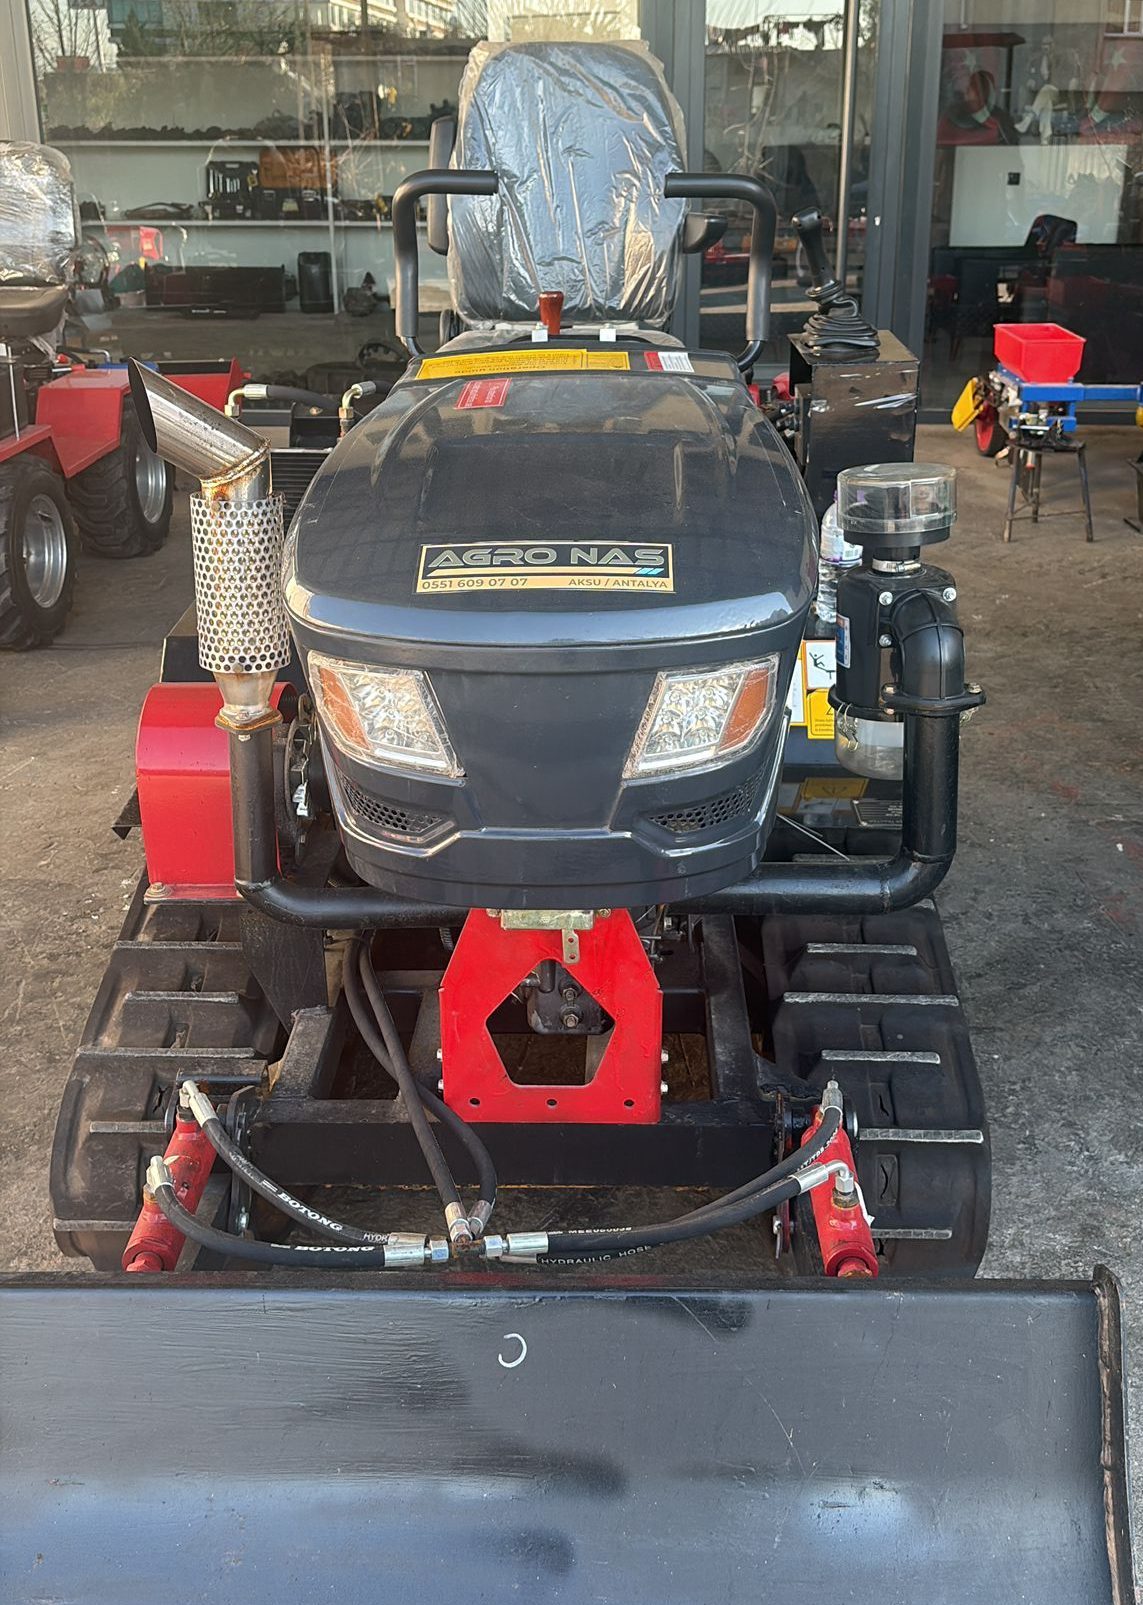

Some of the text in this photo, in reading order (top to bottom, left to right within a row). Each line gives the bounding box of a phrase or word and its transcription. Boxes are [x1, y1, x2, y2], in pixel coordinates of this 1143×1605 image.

[428, 547, 664, 567] AGRO NAS
[422, 580, 453, 590] 0551
[457, 579, 484, 588] 609
[488, 578, 506, 587] 07
[510, 578, 528, 586] 07
[568, 578, 601, 587] AKSU
[613, 578, 668, 588] ANTALYA
[278, 1191, 344, 1232] BOTONG
